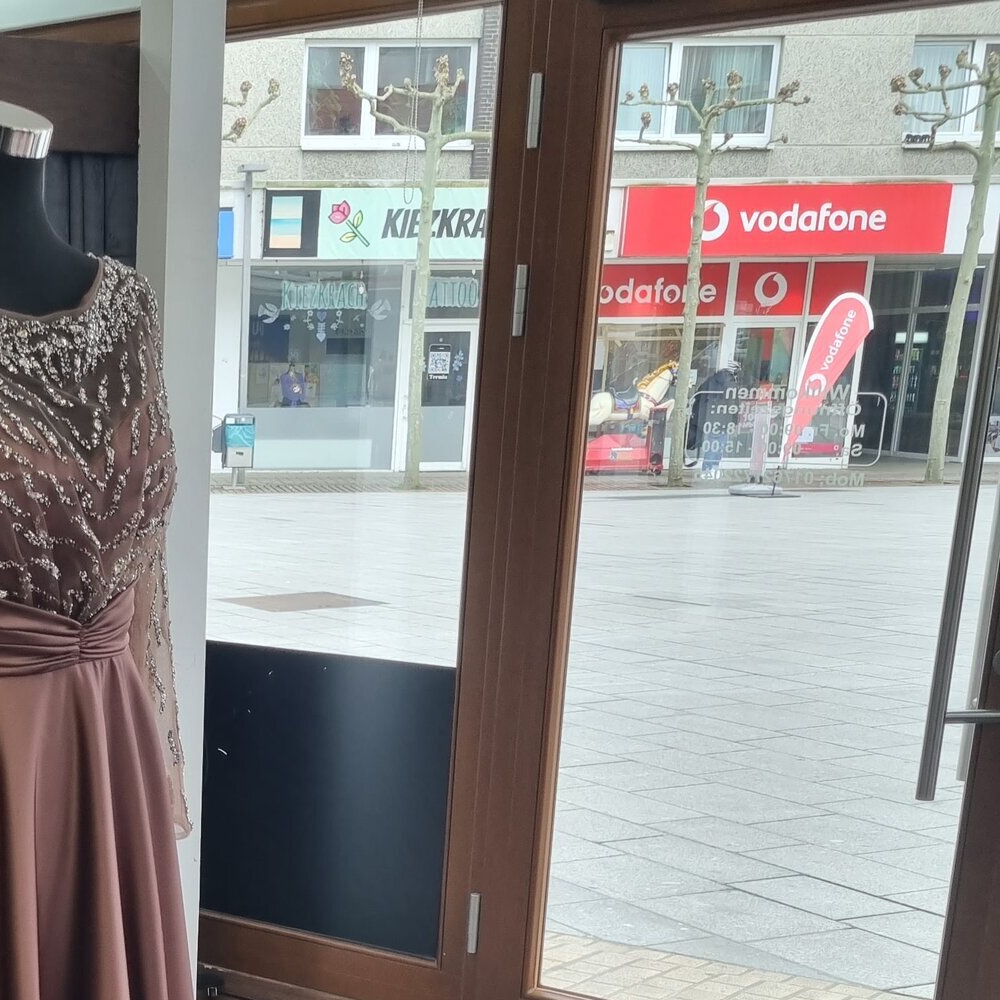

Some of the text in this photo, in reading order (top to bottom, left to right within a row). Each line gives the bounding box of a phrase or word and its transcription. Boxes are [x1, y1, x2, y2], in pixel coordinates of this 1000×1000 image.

[739, 202, 887, 233] vodafone
[600, 277, 717, 304] odafoe
[820, 309, 857, 371] vodafone
